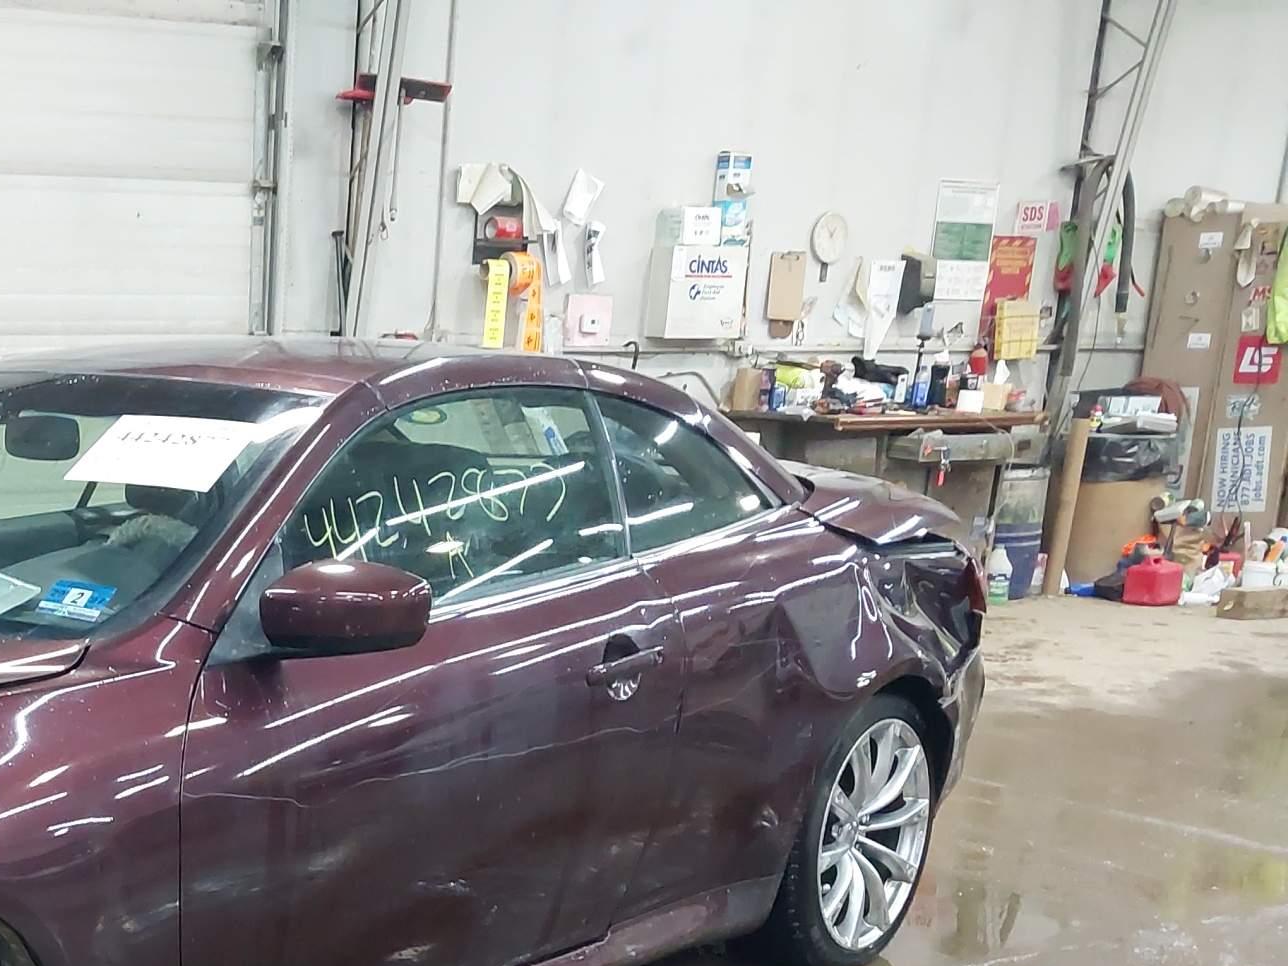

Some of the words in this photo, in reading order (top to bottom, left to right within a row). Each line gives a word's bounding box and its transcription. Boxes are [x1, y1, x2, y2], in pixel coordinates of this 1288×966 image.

[1022, 206, 1044, 222] SDS
[689, 255, 728, 274] CINTAS
[1219, 432, 1231, 474] HIRING
[1216, 478, 1227, 508] NOW
[70, 592, 85, 604] 2
